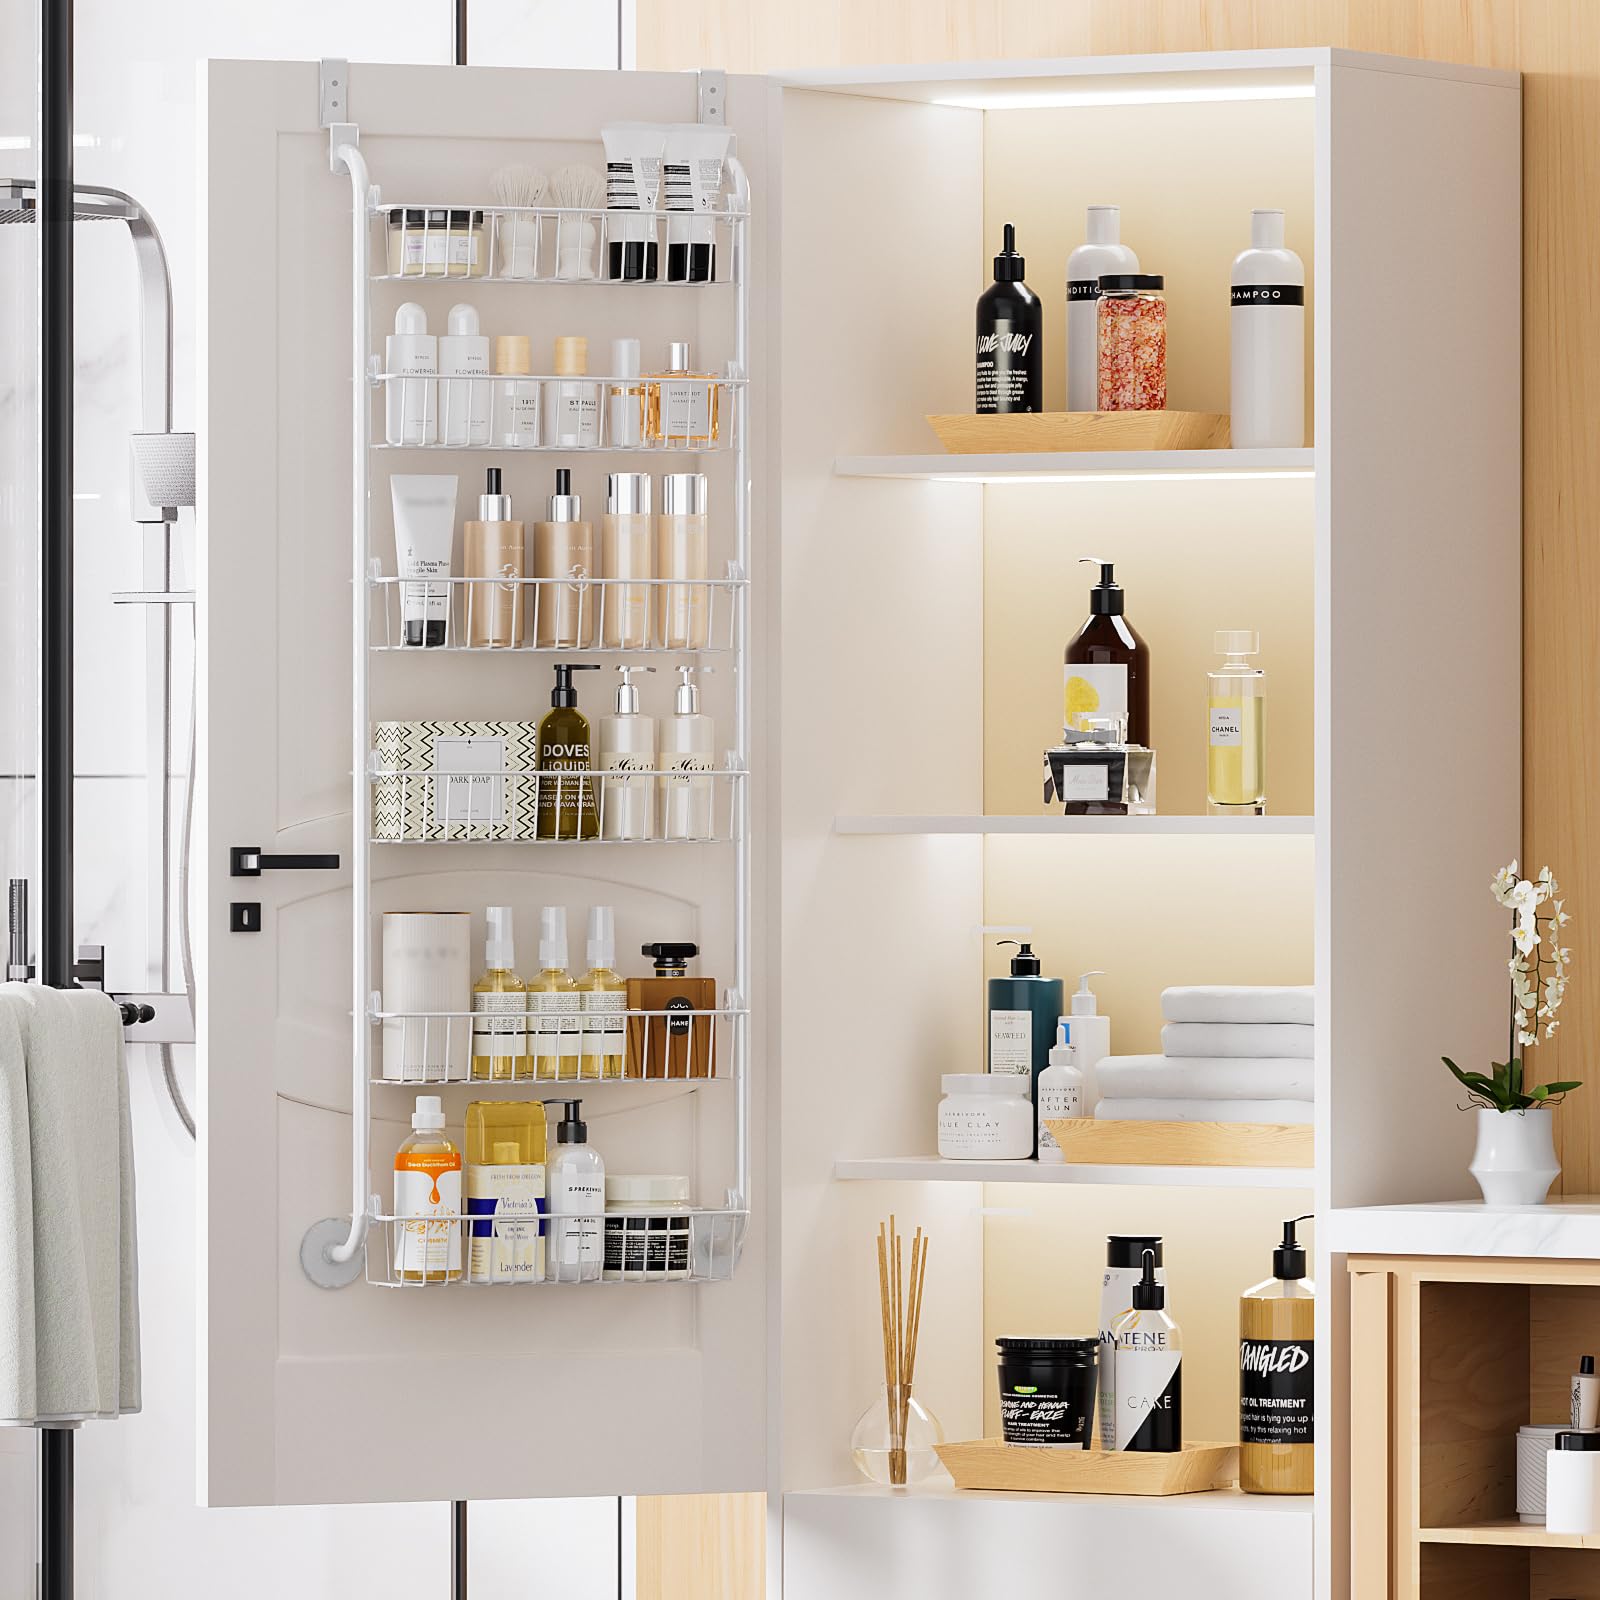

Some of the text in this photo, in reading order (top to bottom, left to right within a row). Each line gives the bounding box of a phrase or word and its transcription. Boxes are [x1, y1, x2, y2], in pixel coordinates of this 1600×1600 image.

[980, 333, 999, 354] LOVE
[1000, 333, 1033, 357] JUICY
[543, 744, 590, 757] DOVES
[450, 776, 491, 784] DARK SOAP
[994, 1032, 1026, 1040] SEAWEED
[500, 1262, 533, 1273] Lavender
[1240, 1341, 1310, 1378] TANGLED
[1020, 1401, 1038, 1409] AND
[1038, 1401, 1070, 1409] HENNA
[1127, 1395, 1172, 1410] CAKE
[1249, 1398, 1258, 1407] OIL
[1258, 1398, 1306, 1408] TREATMENT
[1266, 1414, 1281, 1424] tying
[1282, 1415, 1295, 1424] you
[1297, 1415, 1308, 1424] up
[1267, 1426, 1292, 1435] relaxing
[1293, 1426, 1307, 1434] hot
